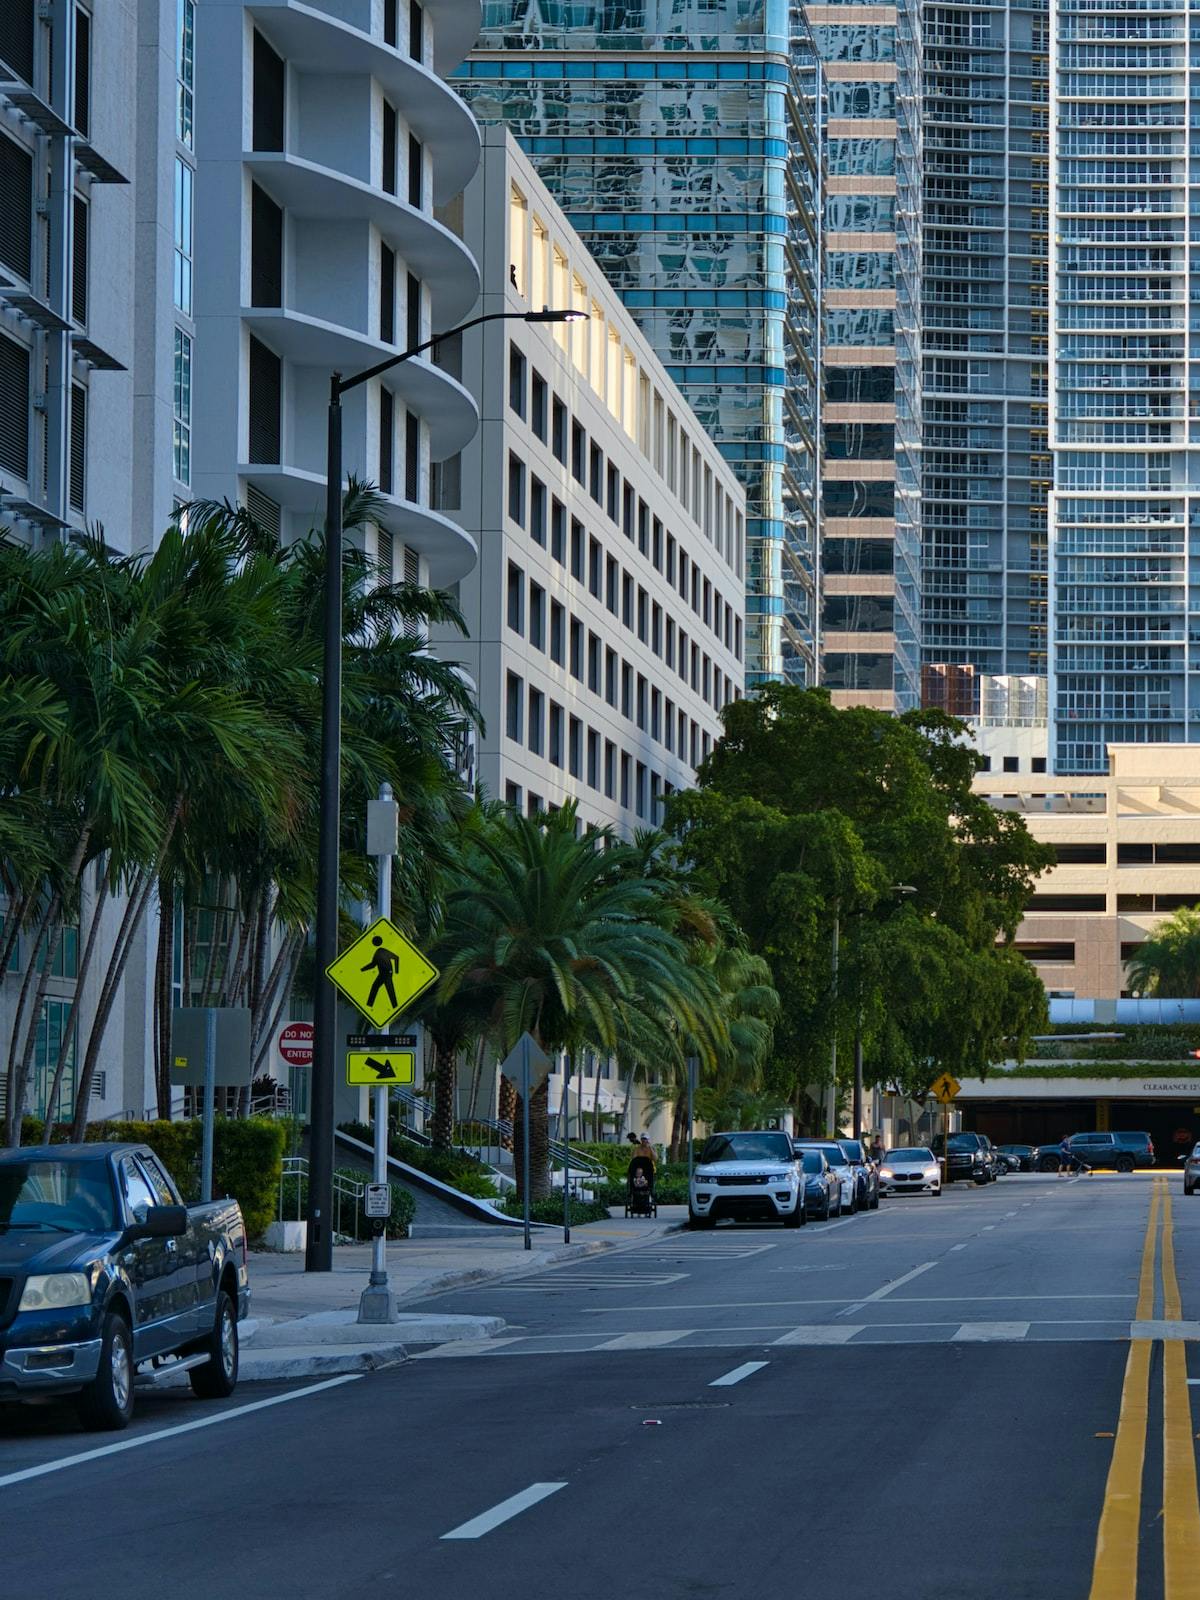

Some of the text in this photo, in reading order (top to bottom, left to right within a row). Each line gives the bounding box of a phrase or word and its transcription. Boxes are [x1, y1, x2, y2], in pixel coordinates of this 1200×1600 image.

[285, 1030, 297, 1038] DO
[287, 1050, 313, 1058] ENTER
[1143, 1083, 1188, 1091] CLEARANCE
[768, 1118, 776, 1128] P
